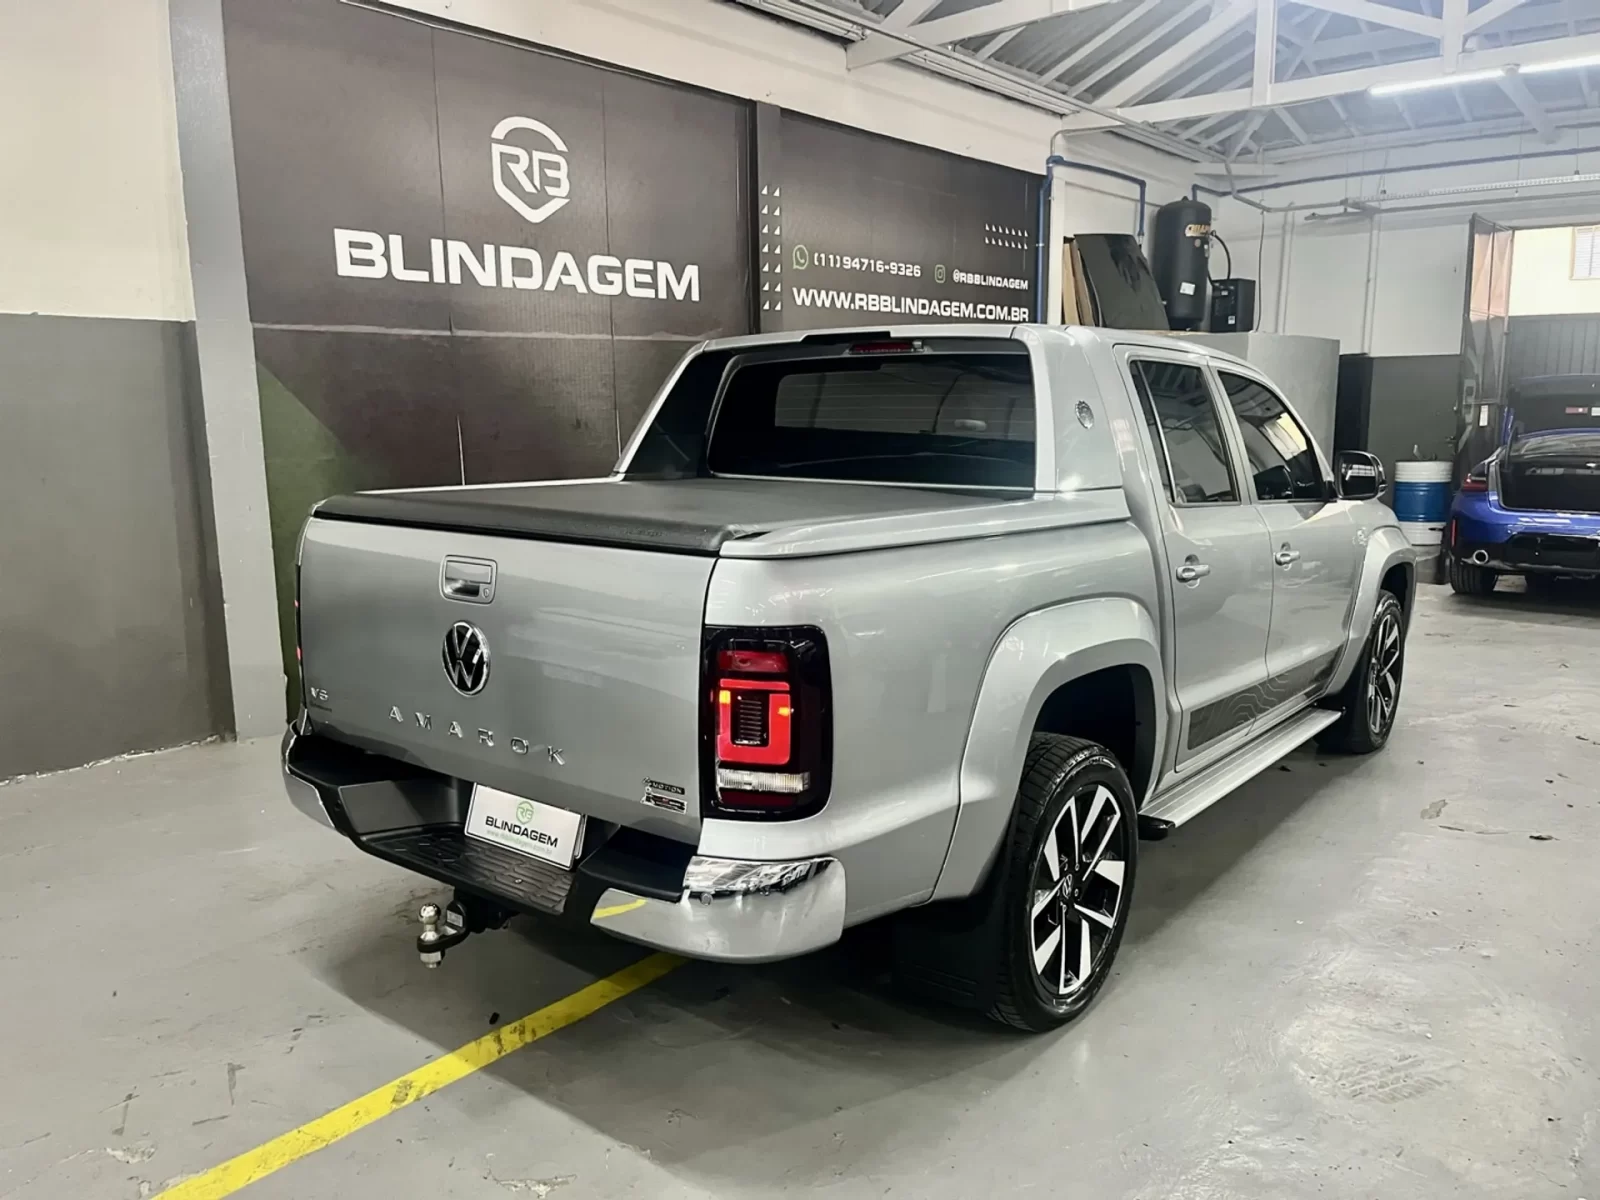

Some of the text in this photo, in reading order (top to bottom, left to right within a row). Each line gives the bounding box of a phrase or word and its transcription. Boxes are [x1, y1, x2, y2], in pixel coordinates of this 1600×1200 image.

[334, 228, 699, 302] BLINDAGEM
[814, 252, 921, 277] (11)94716-9326
[953, 269, 1029, 290] @RBBLINDAGEM
[792, 287, 1029, 322] WWW.RBBLINDAGEM.COM.BR
[389, 705, 566, 766] AMAROK
[485, 816, 559, 848] BLINDAGEM
